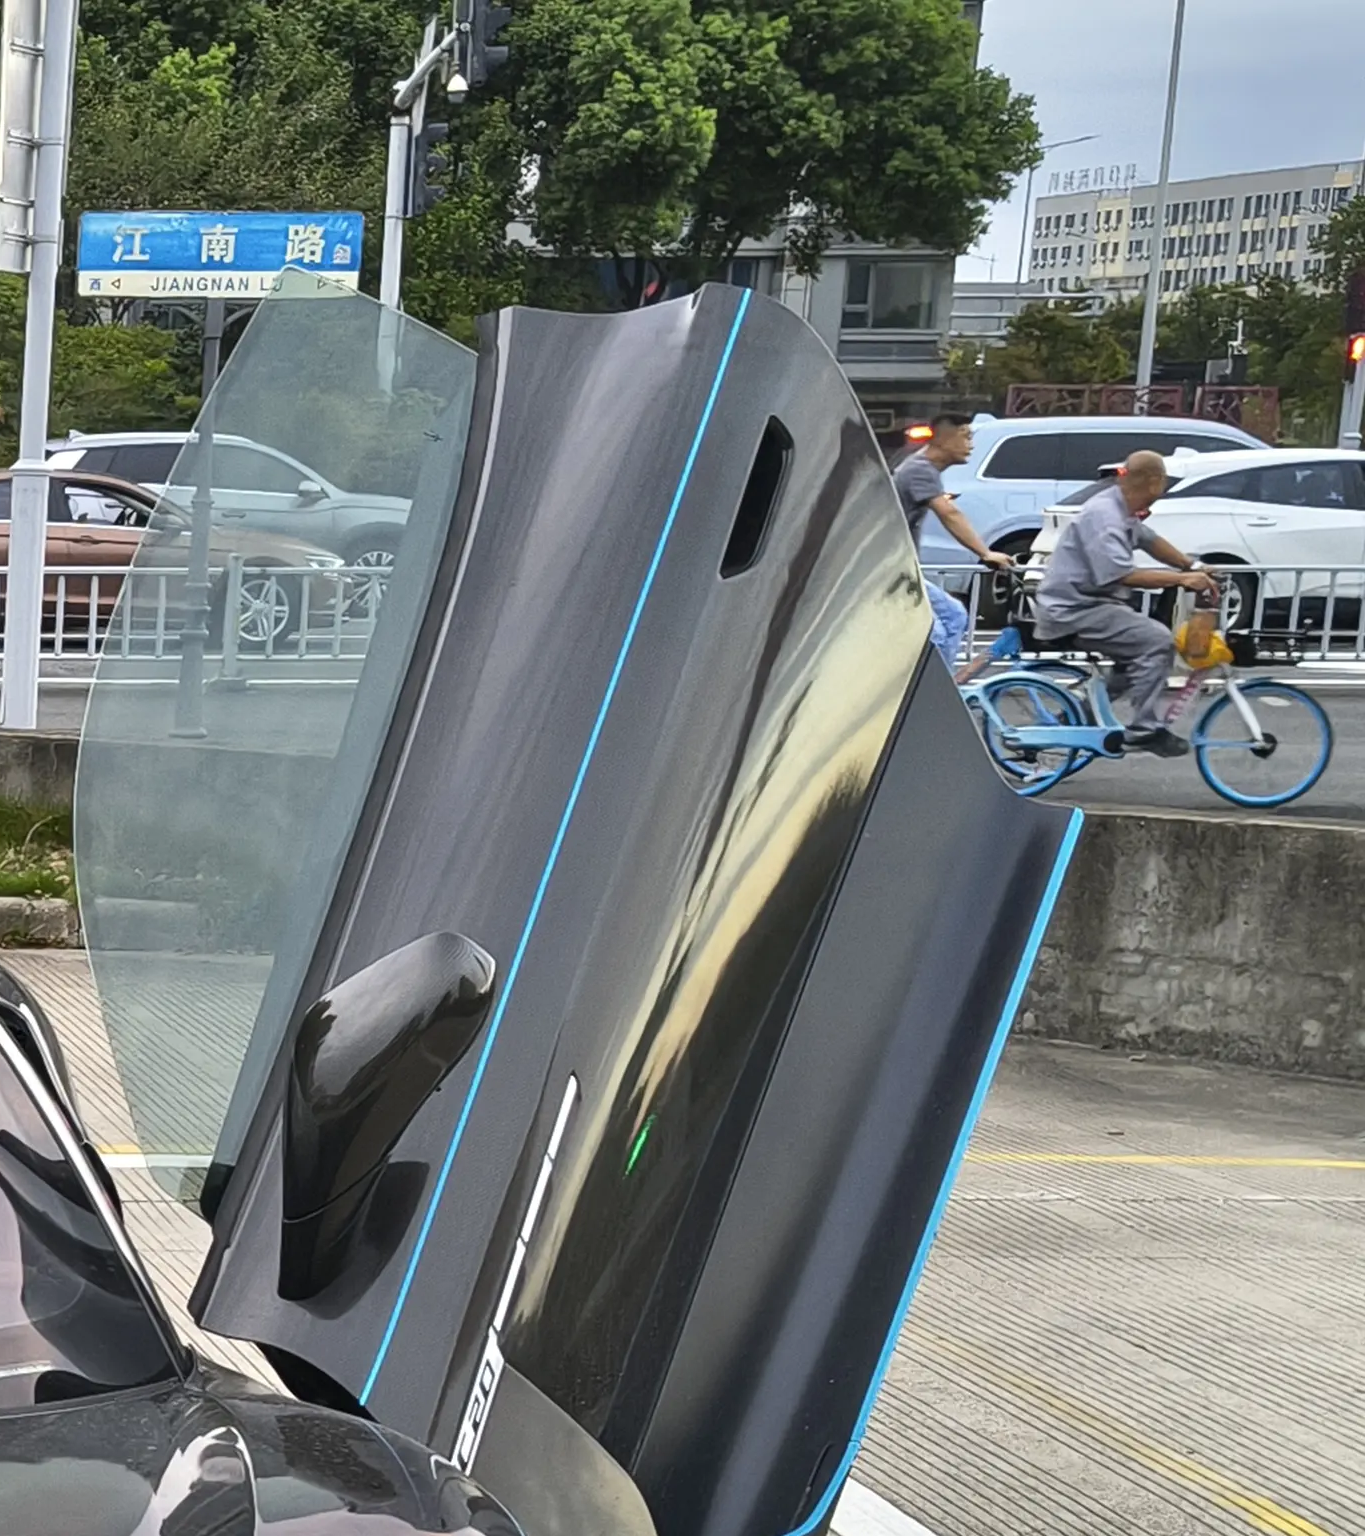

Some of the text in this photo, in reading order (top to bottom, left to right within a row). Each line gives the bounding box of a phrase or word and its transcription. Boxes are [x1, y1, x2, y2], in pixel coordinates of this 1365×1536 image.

[112, 223, 326, 264] 江南路
[150, 277, 249, 291] JIANGNAN
